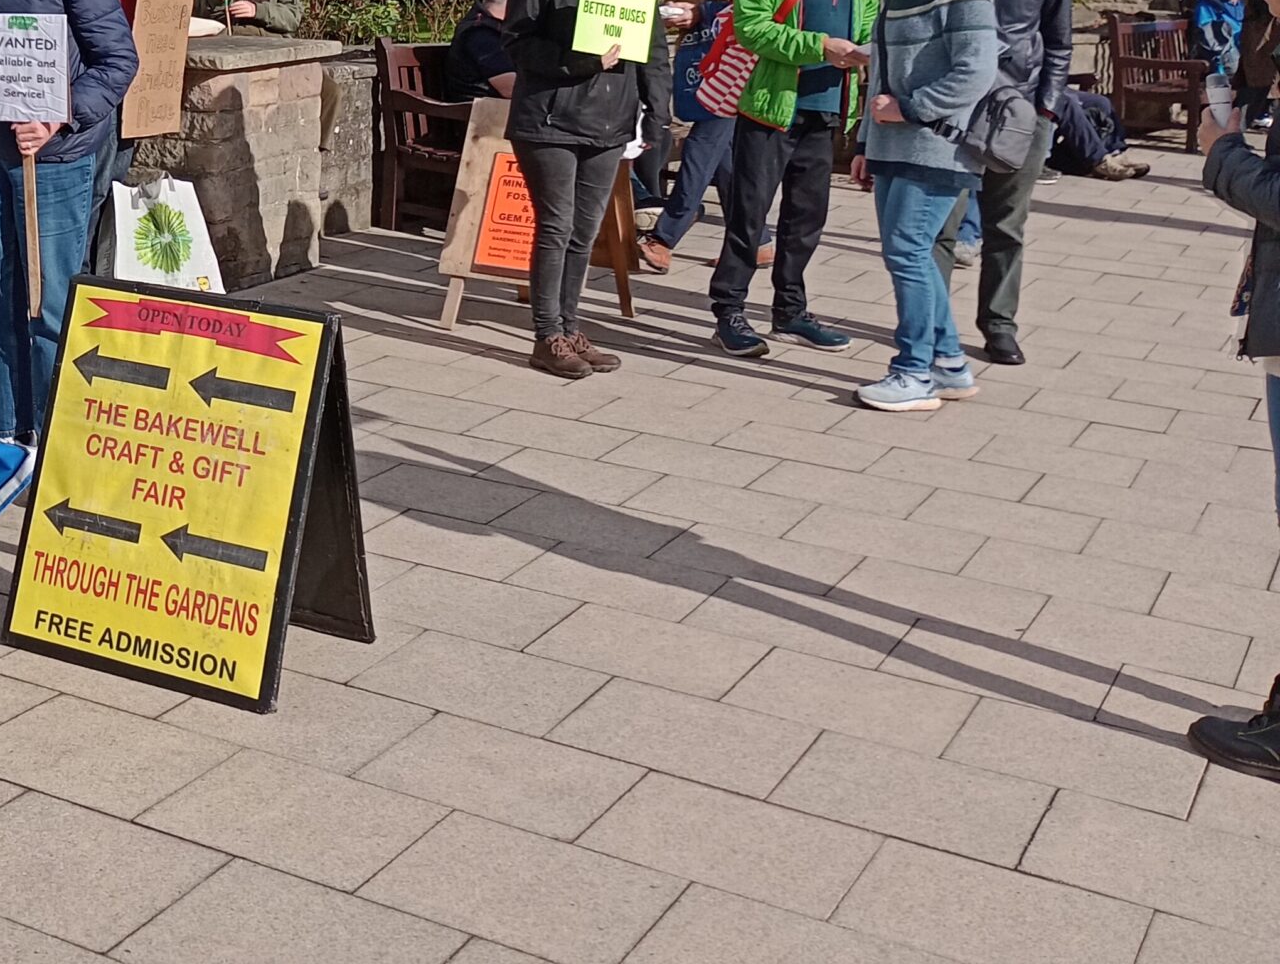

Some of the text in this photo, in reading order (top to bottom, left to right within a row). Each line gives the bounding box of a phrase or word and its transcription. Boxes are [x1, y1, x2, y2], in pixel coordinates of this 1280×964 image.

[583, 0, 647, 24] BETTER BUSES
[603, 23, 623, 38] NOW
[37, 59, 56, 68] and
[37, 74, 56, 84] Bus
[3, 87, 46, 99] Service!
[498, 213, 522, 223] GEM
[138, 307, 247, 338] OPEN TODAY
[84, 397, 266, 456] THE BAKEWELL
[85, 433, 252, 488] CRAFT & GIFT
[131, 477, 187, 511] FAIR
[33, 550, 260, 637] THROUGH THE GARDENS
[34, 609, 237, 683] FREE ADMISSION
